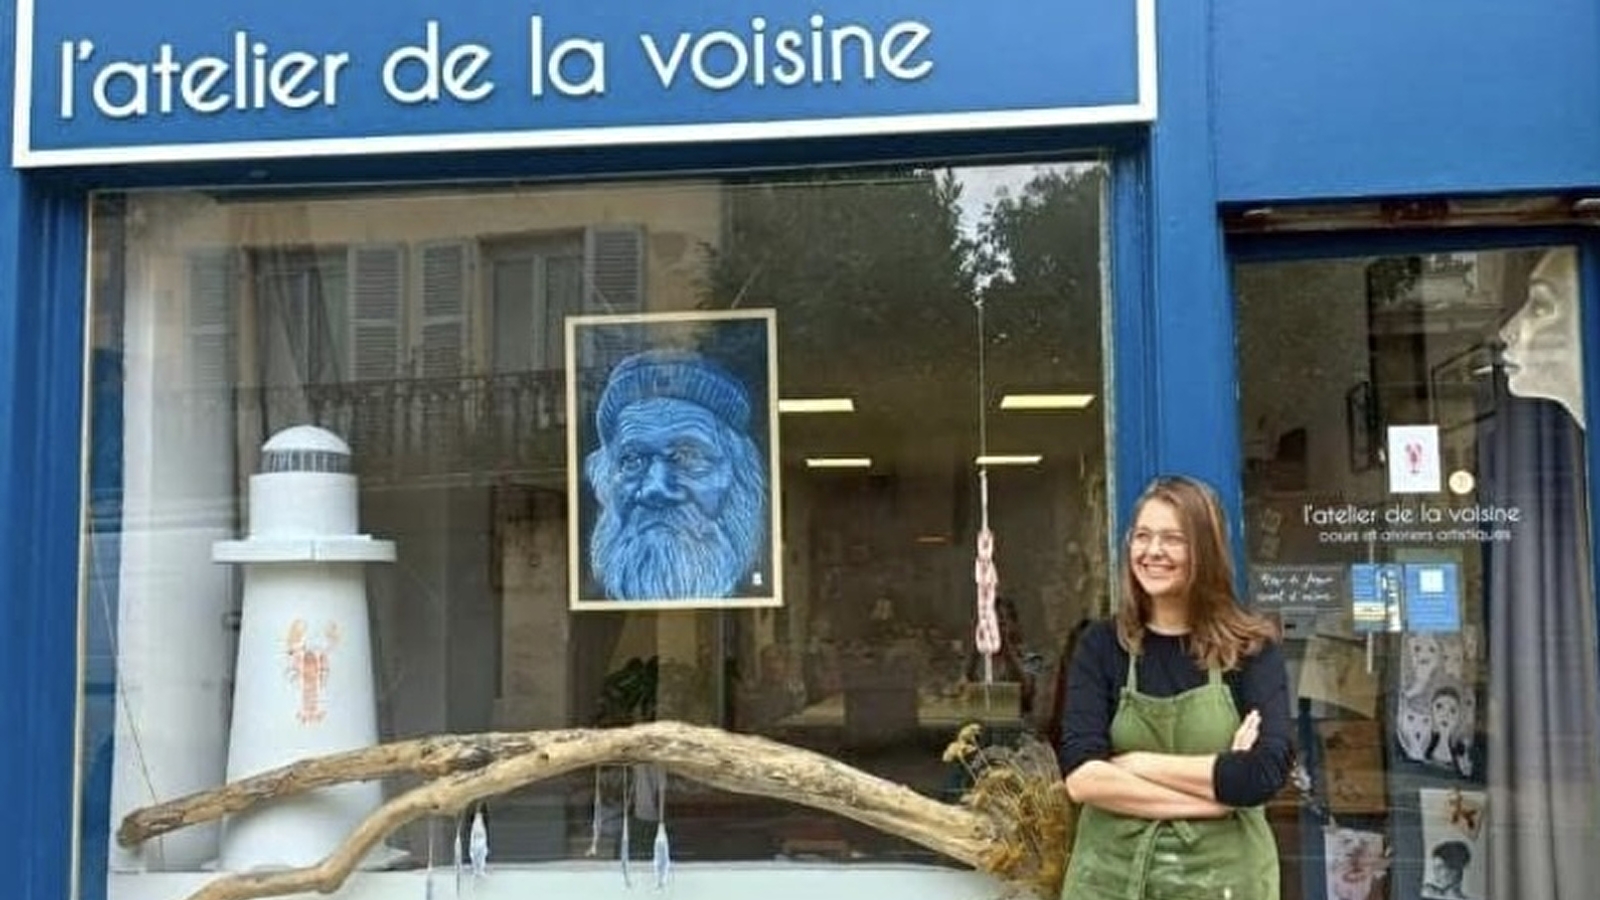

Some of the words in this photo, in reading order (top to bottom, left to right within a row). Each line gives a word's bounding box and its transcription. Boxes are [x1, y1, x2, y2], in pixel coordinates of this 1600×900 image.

[60, 31, 350, 118] l'atelier
[382, 20, 494, 104] de
[530, 15, 606, 96] la
[640, 15, 935, 90] voisine
[1384, 503, 1414, 523] de
[1420, 503, 1442, 523] la
